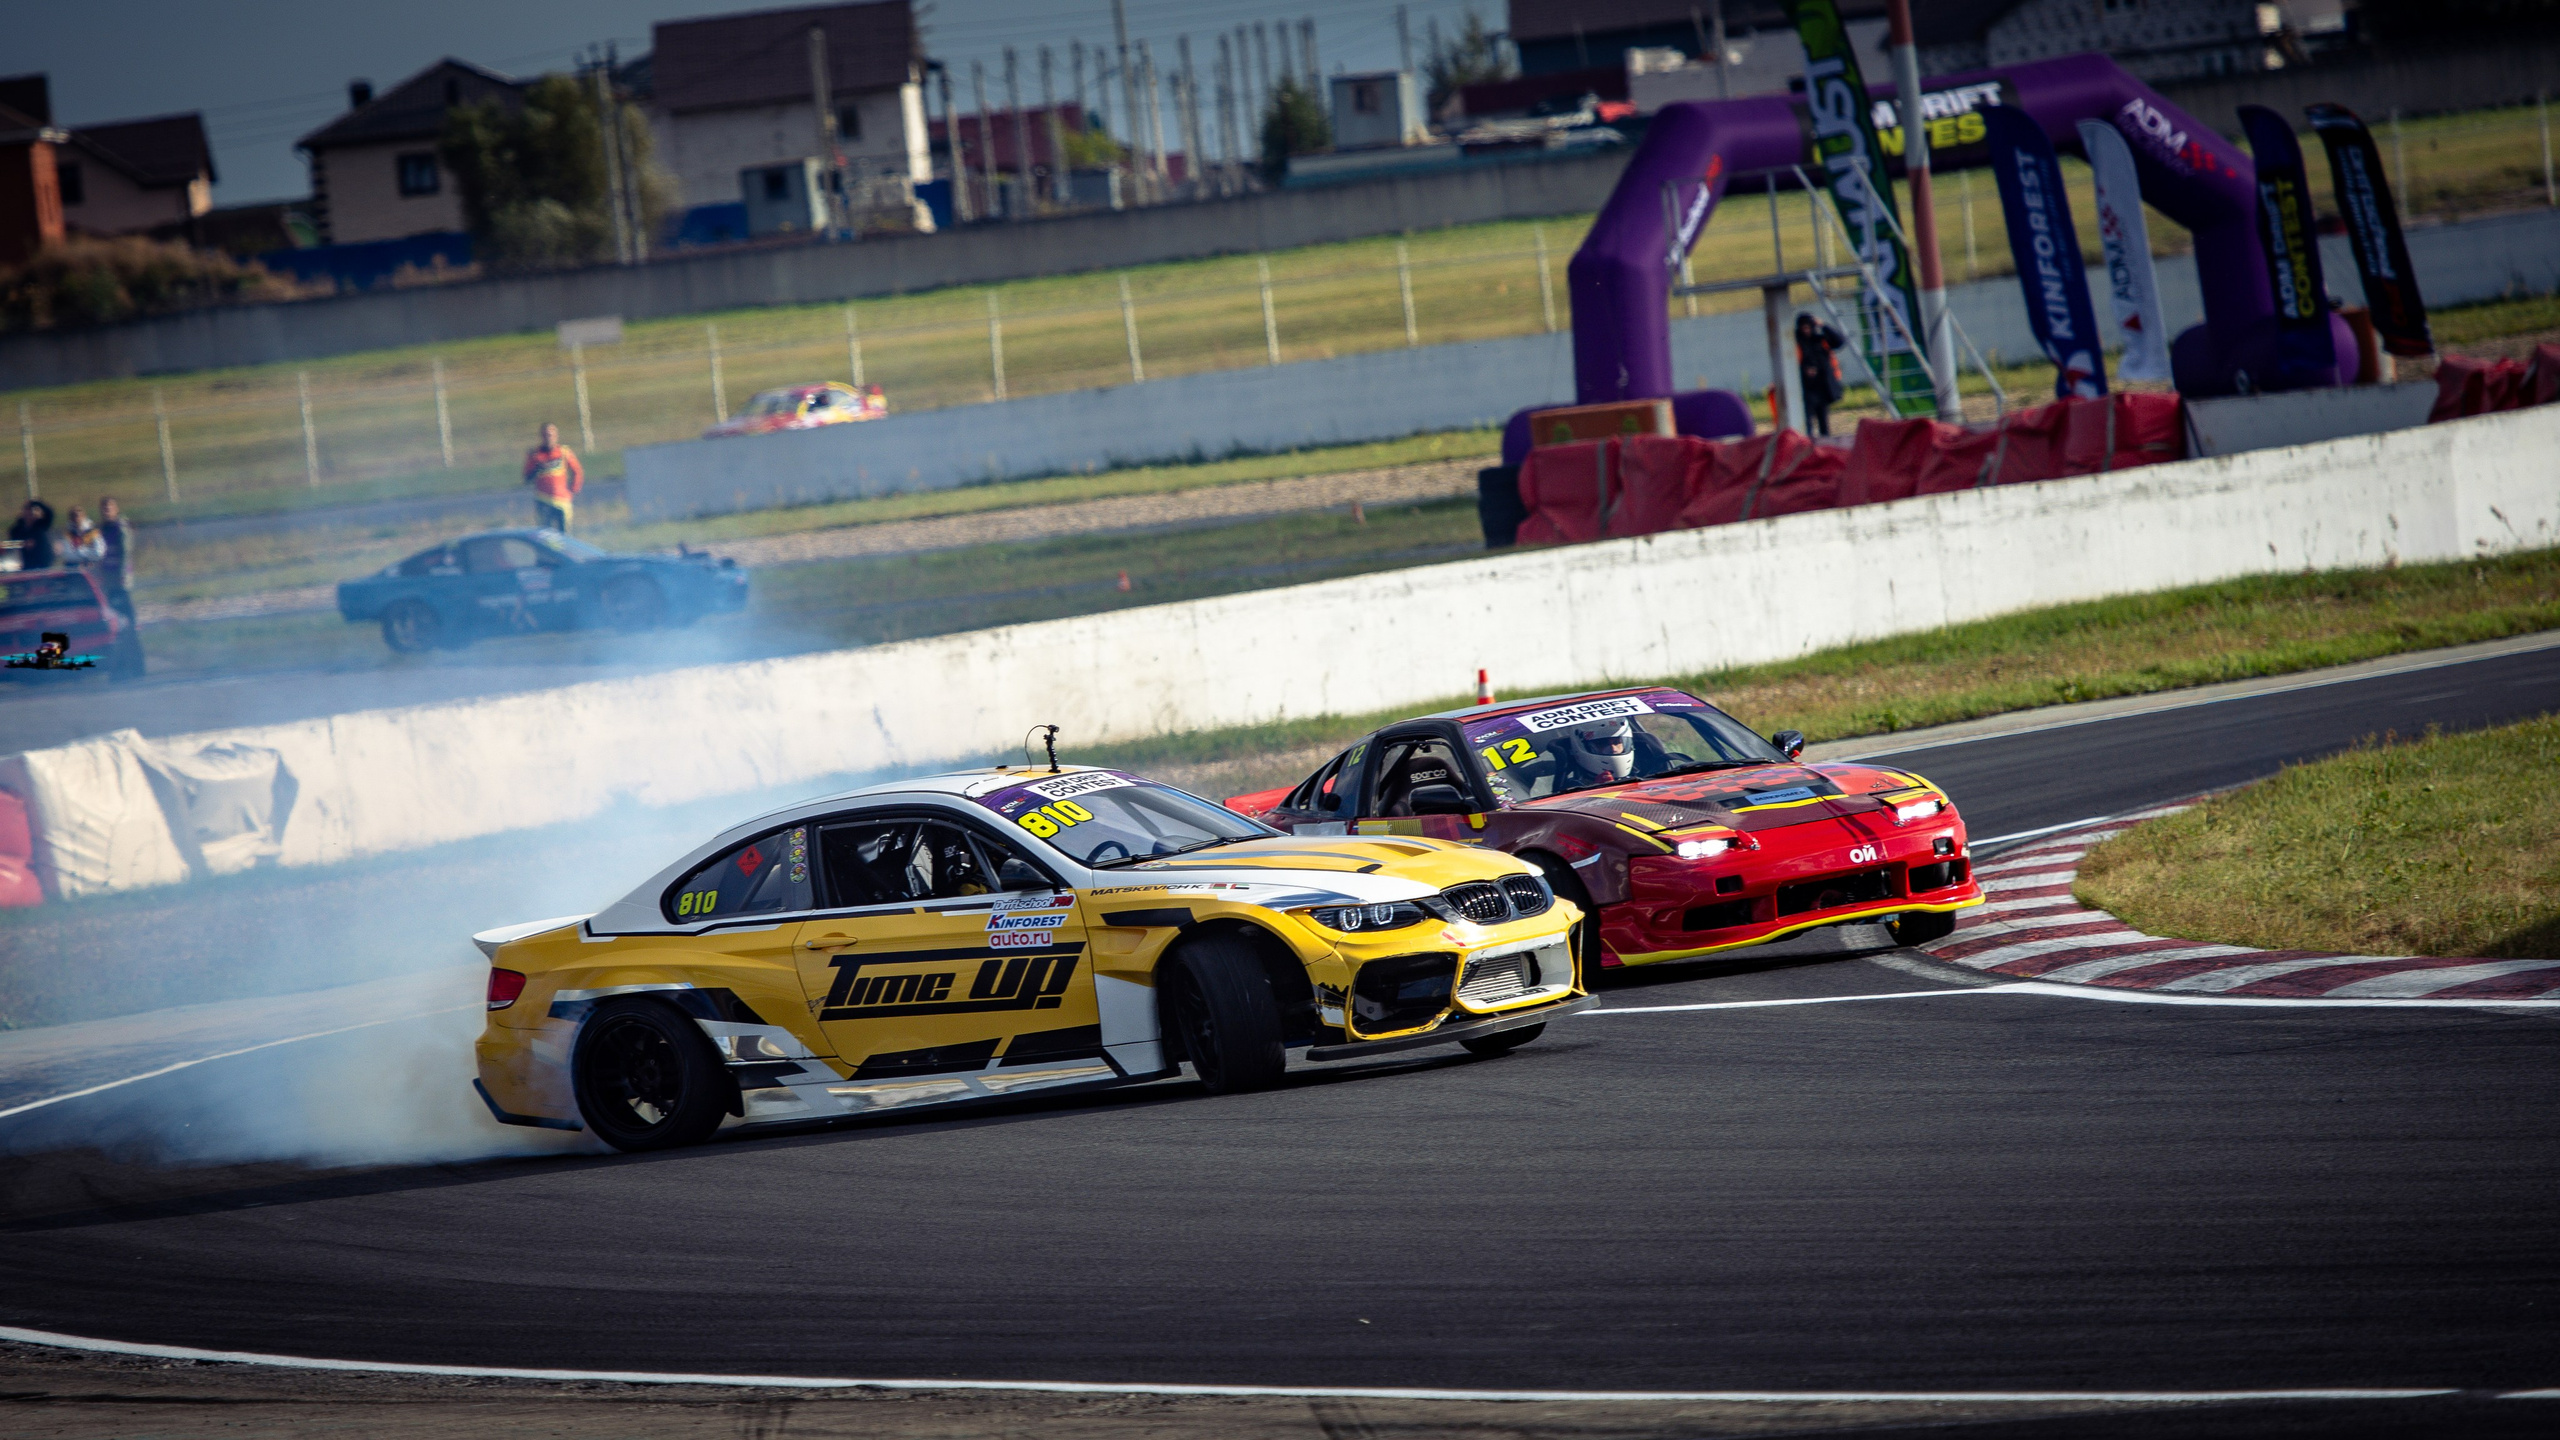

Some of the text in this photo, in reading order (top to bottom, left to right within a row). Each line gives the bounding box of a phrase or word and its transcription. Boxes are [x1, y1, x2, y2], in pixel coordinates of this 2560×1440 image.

[2122, 97, 2187, 154] ADM
[2014, 147, 2075, 340] KINFOREST
[2276, 177, 2316, 319] CONTEST
[1531, 699, 1632, 723] ADM DRIFT
[1536, 704, 1639, 728] CONTEST
[1347, 744, 1367, 768] 12
[1481, 737, 1538, 771] 12
[1037, 778, 1072, 792] ADM
[1410, 768, 1448, 781] sparco
[1049, 778, 1123, 797] CONTEST
[1017, 799, 1094, 839] 810
[1849, 844, 1878, 863] ОЙ
[1090, 884, 1189, 896] MATSKEVICH
[678, 890, 718, 916] 810
[987, 914, 1066, 929] KINFOREST
[991, 932, 1051, 948] auto.ru
